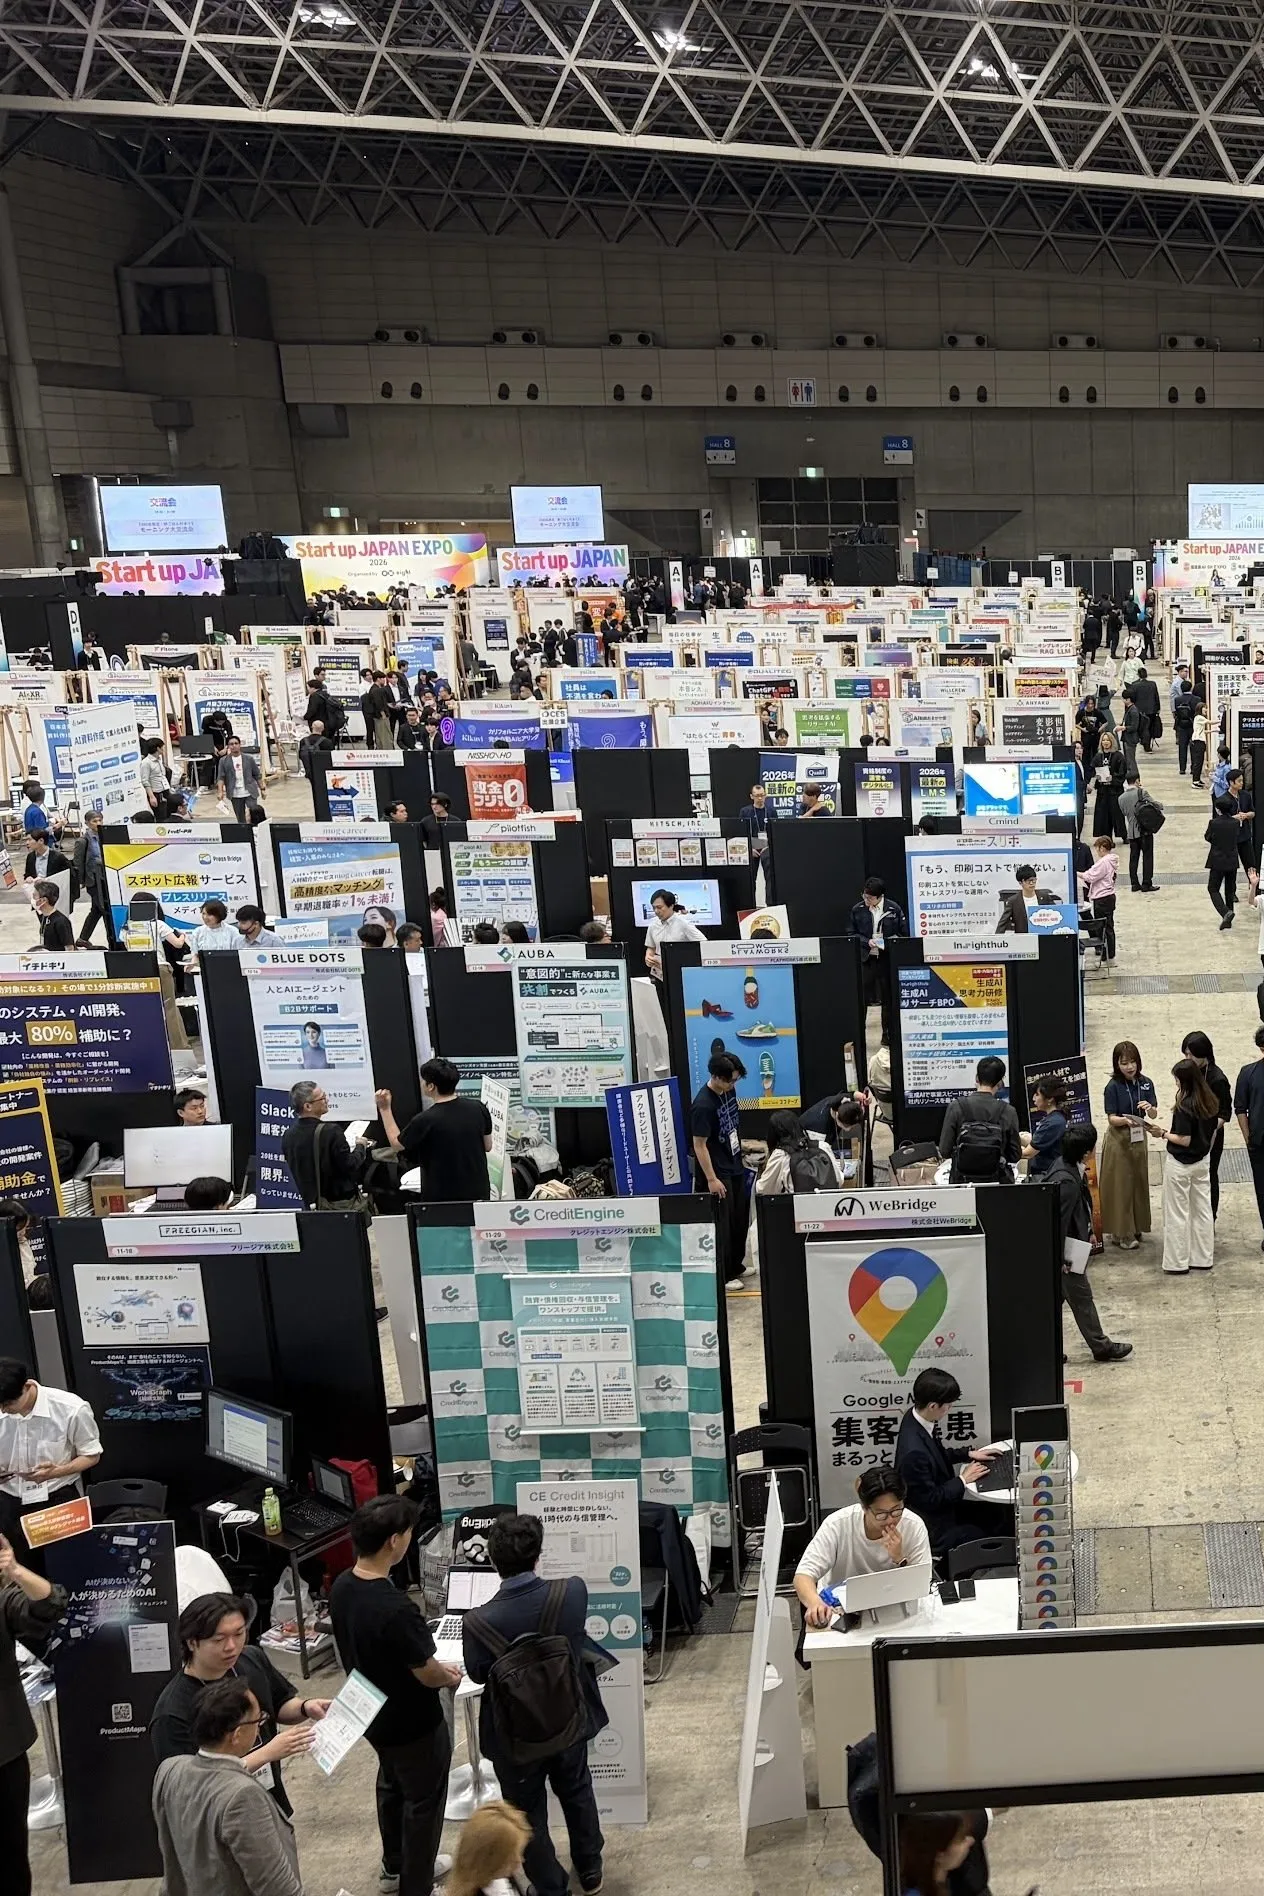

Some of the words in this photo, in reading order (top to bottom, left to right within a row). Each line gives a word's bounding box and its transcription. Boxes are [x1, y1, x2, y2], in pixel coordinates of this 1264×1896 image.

[724, 438, 730, 448] 8
[901, 438, 909, 448] 8
[149, 497, 177, 508] 交流会
[358, 538, 409, 558] JAPAN
[412, 538, 453, 556] EXPO
[1222, 543, 1256, 554] JAPAN
[570, 548, 626, 569] JAPAN
[673, 567, 680, 577] A
[753, 563, 760, 573] A
[1054, 566, 1062, 575] B
[1136, 566, 1143, 575] B
[70, 611, 77, 624] D
[565, 684, 587, 692] 社員は
[762, 771, 796, 781] 2026年
[919, 768, 945, 776] 2026年
[920, 777, 946, 787] 最新の
[766, 782, 795, 794] 最新の
[920, 788, 946, 798] LMS
[503, 779, 525, 808] 0
[773, 797, 794, 808] LMS
[989, 816, 1019, 826] Cmind
[323, 828, 342, 836] mog
[501, 823, 537, 833] pilotfish
[128, 873, 248, 887] スポット広報サービス
[918, 880, 990, 889] 印刷コストを気にしない
[919, 888, 990, 897] ストレスフリーな運用へ
[271, 953, 305, 964] BLUE
[309, 952, 346, 964] DOTS
[518, 949, 555, 959] AUBA
[22, 961, 65, 971] イチドキリ
[266, 984, 346, 994] 人とAIエージェント
[520, 984, 576, 997] 共創でつくる
[901, 988, 928, 998] 生成AI
[959, 988, 1003, 998] 思考力研修
[284, 1004, 334, 1014] B2Bサポート
[31, 1025, 74, 1043] 80%
[79, 1028, 132, 1043] 補助に？
[260, 1103, 295, 1119] Slack
[634, 1093, 651, 1160] アクセシビリティ
[657, 1090, 675, 1180] インクルーシブデザイン
[869, 1198, 937, 1212] WeBridge
[534, 1206, 625, 1222] CreditEngine
[911, 1216, 972, 1226] 株式会社WeBridge
[570, 1226, 656, 1236] クレジットエンジン株式会社
[230, 1242, 295, 1252] フリージア株式会社
[539, 1305, 606, 1315] ワンストップで提供。
[843, 1393, 904, 1410] Google
[529, 1491, 547, 1502] CE
[550, 1490, 584, 1502] Credit
[587, 1489, 625, 1502] Insight
[69, 1588, 156, 1602] 人が決めるためのAI
[100, 1726, 147, 1736] ProductMaps
